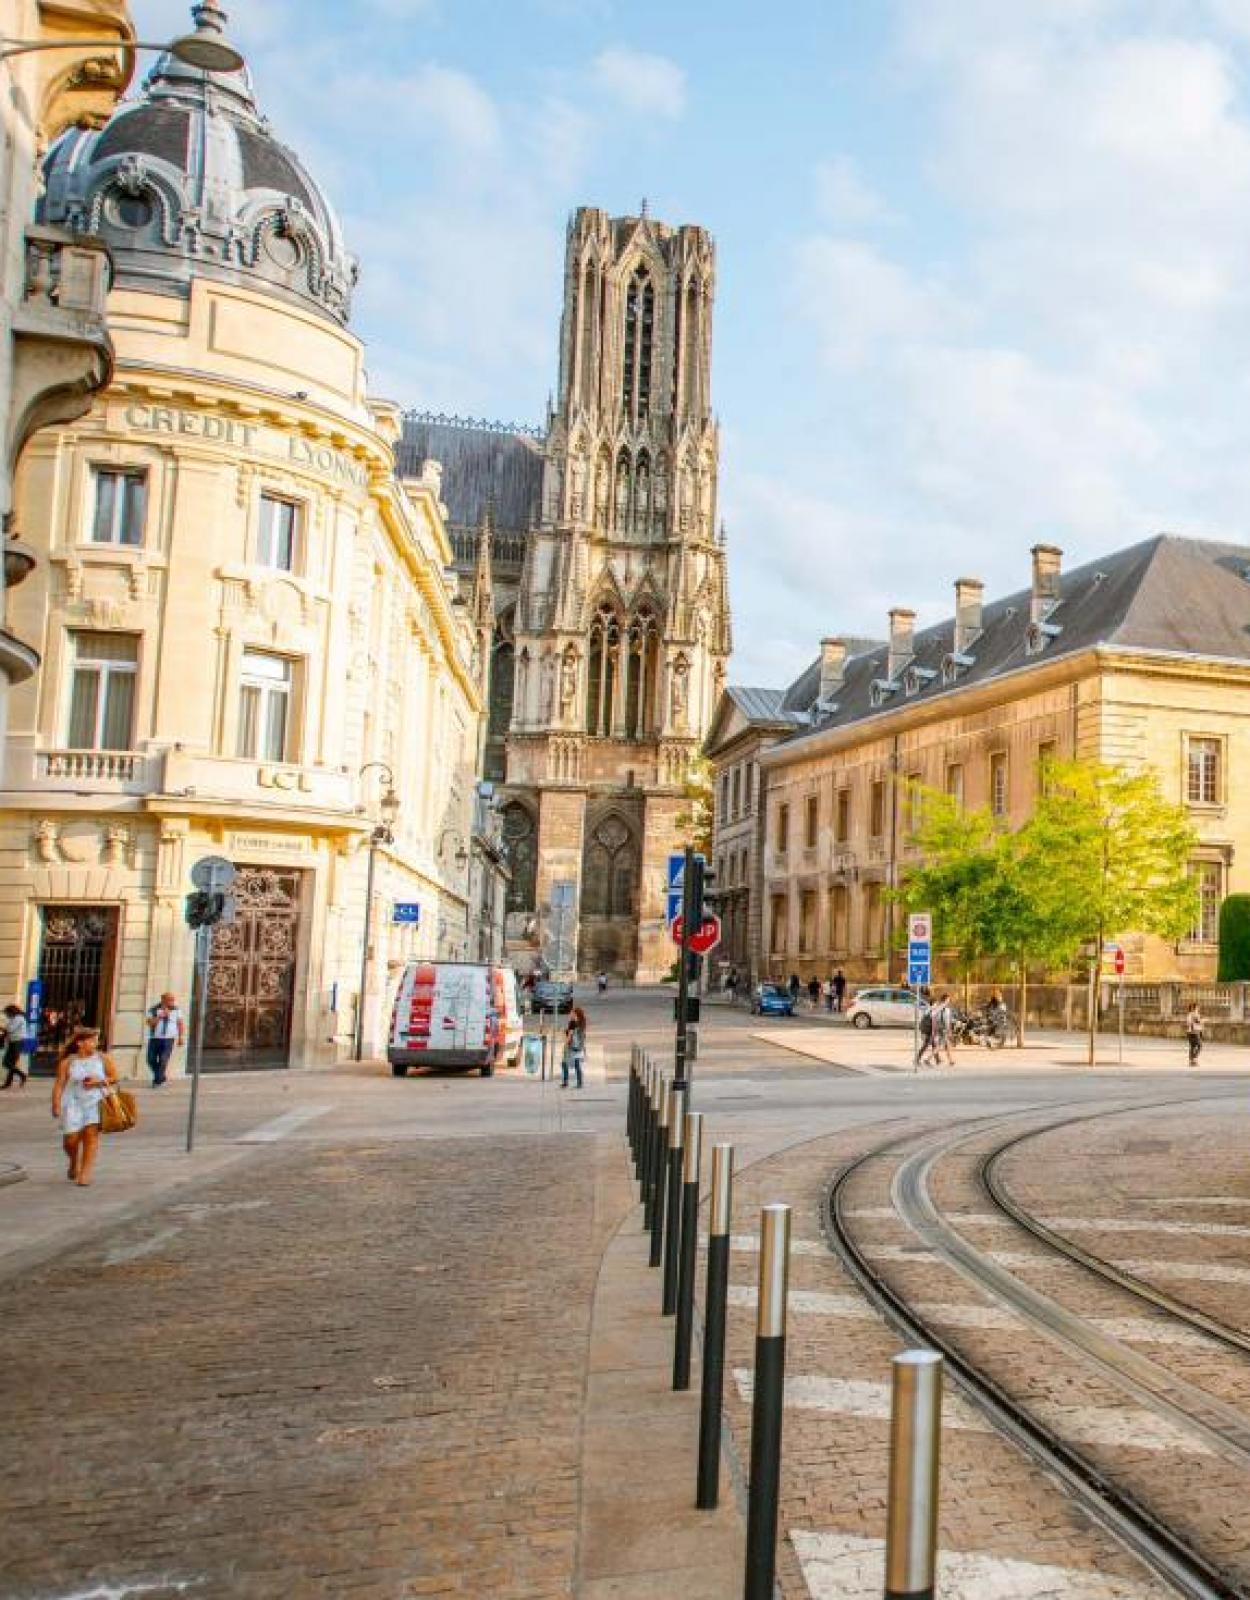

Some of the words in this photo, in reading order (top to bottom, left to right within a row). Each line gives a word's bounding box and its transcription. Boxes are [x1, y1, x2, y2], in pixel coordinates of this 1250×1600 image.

[125, 401, 257, 447] CREDIT
[257, 767, 312, 793] LCL
[676, 924, 715, 937] SOP
